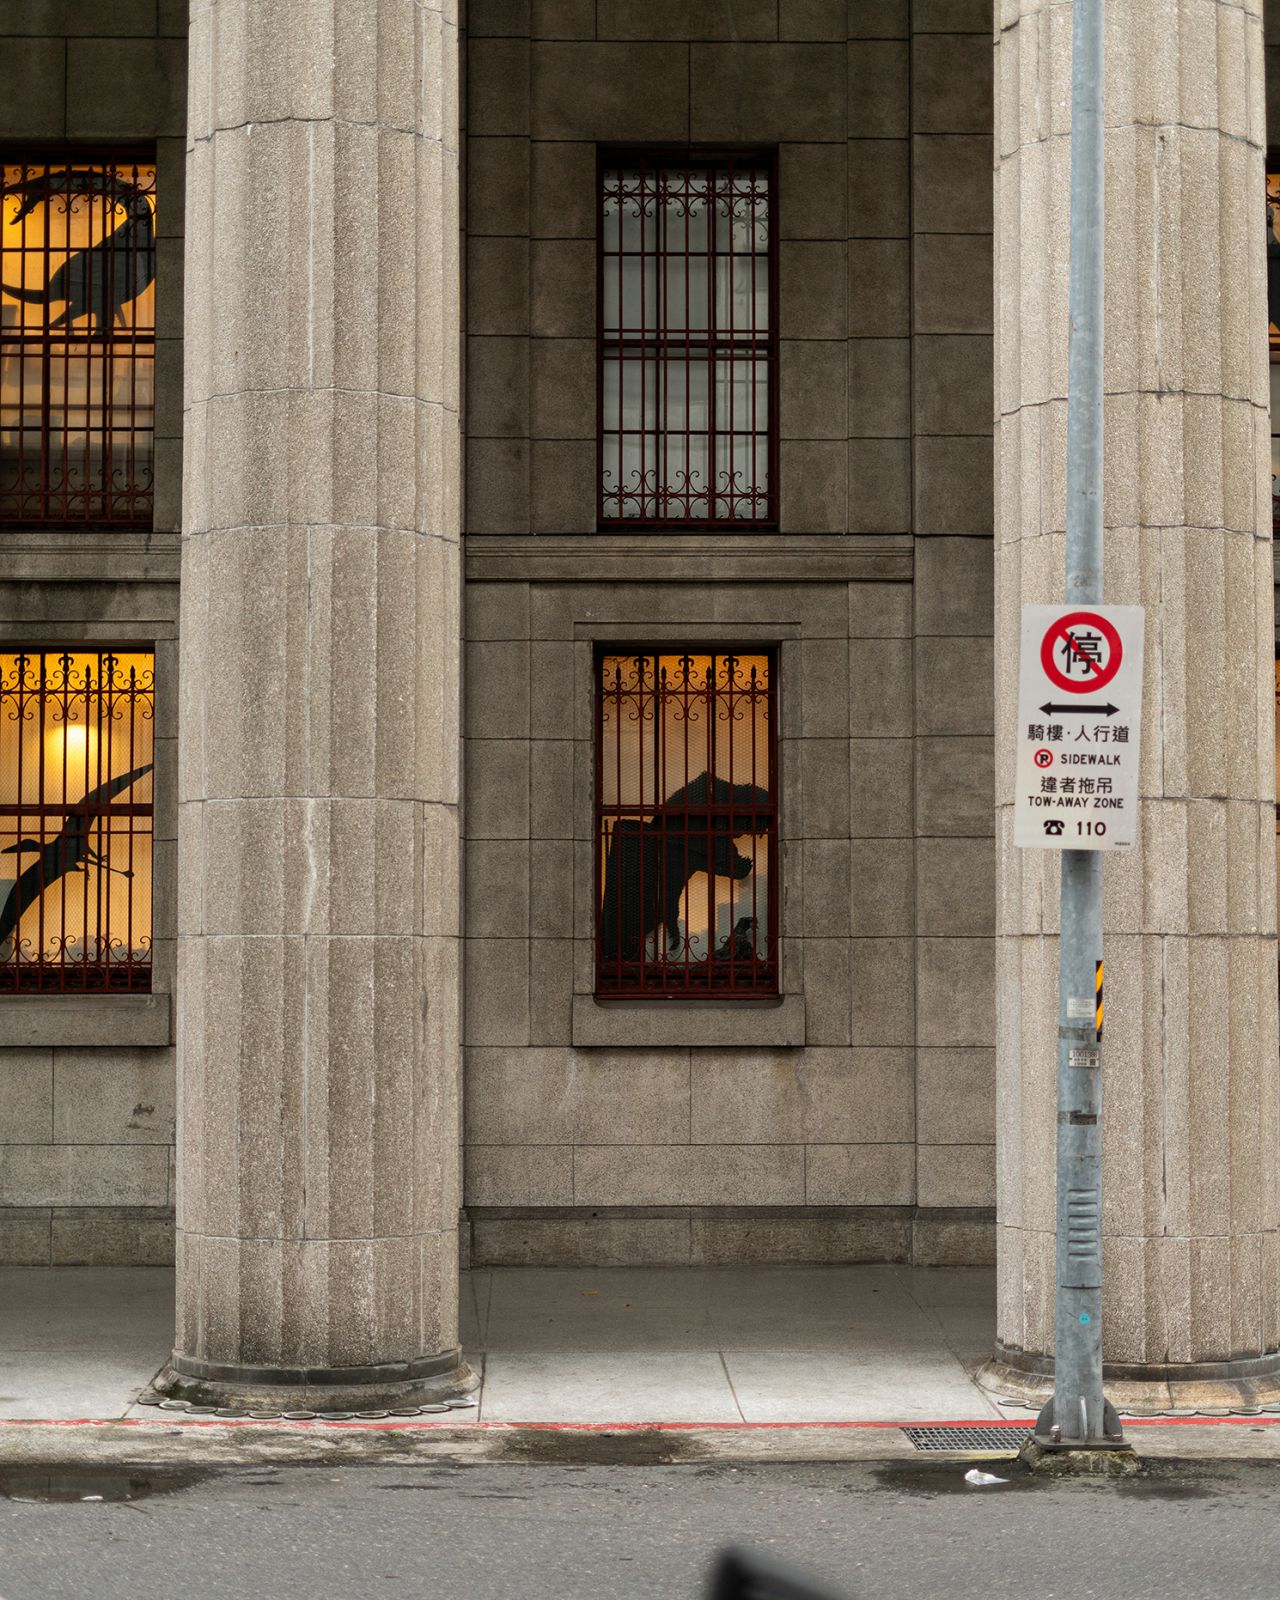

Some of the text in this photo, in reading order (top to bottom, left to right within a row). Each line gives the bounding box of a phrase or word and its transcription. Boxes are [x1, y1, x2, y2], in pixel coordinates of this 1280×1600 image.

[1060, 631, 1103, 675] 停
[1060, 754, 1121, 766] SIDEWALK
[1040, 776, 1113, 794] 違者拖吊
[1028, 796, 1124, 809] TOW-AWAY ZONE
[1076, 821, 1107, 836] 110
